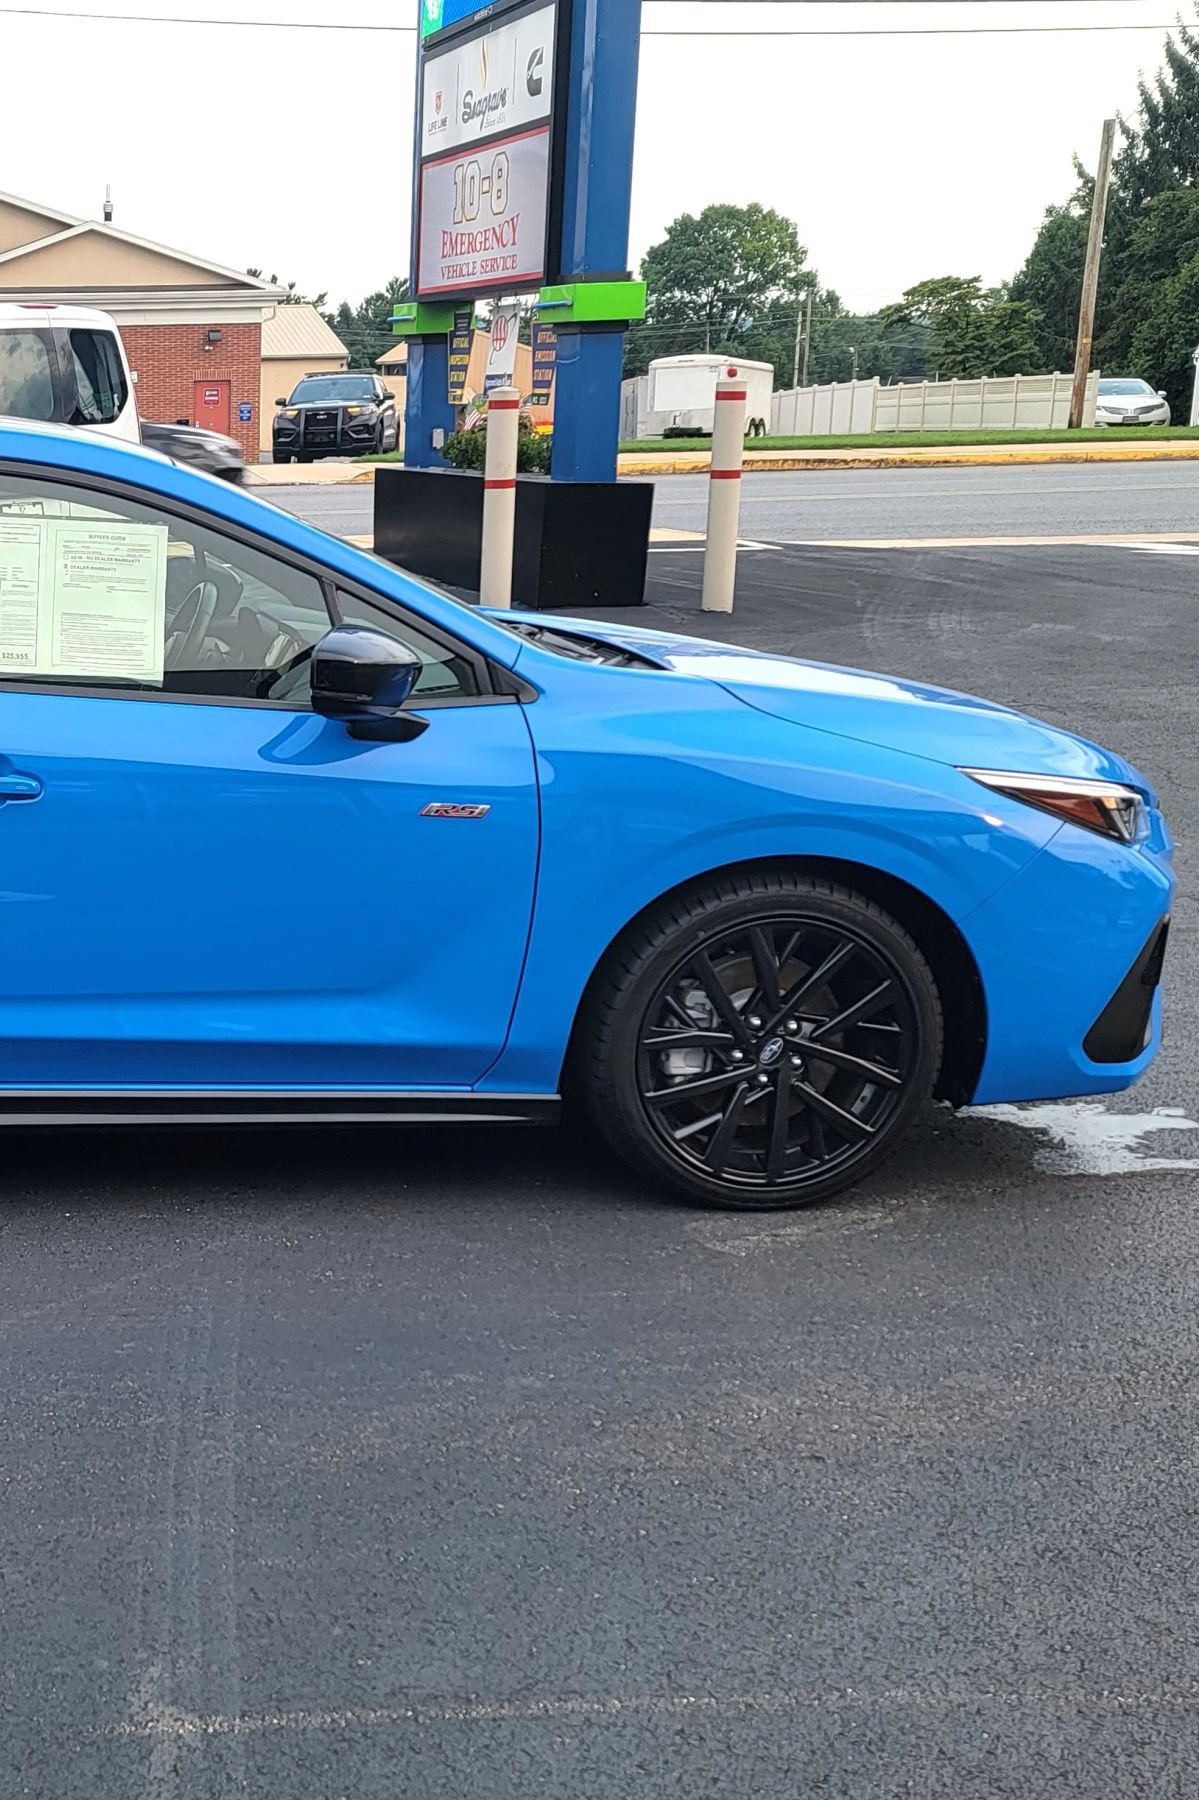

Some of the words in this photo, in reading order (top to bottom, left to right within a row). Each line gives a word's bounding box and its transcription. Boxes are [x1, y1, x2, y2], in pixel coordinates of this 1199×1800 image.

[452, 151, 510, 225] 10-8
[441, 212, 520, 260] EMERGENCY
[440, 261, 478, 280] VEHICLE
[480, 253, 518, 275] SERVICE
[428, 803, 481, 817] RS
